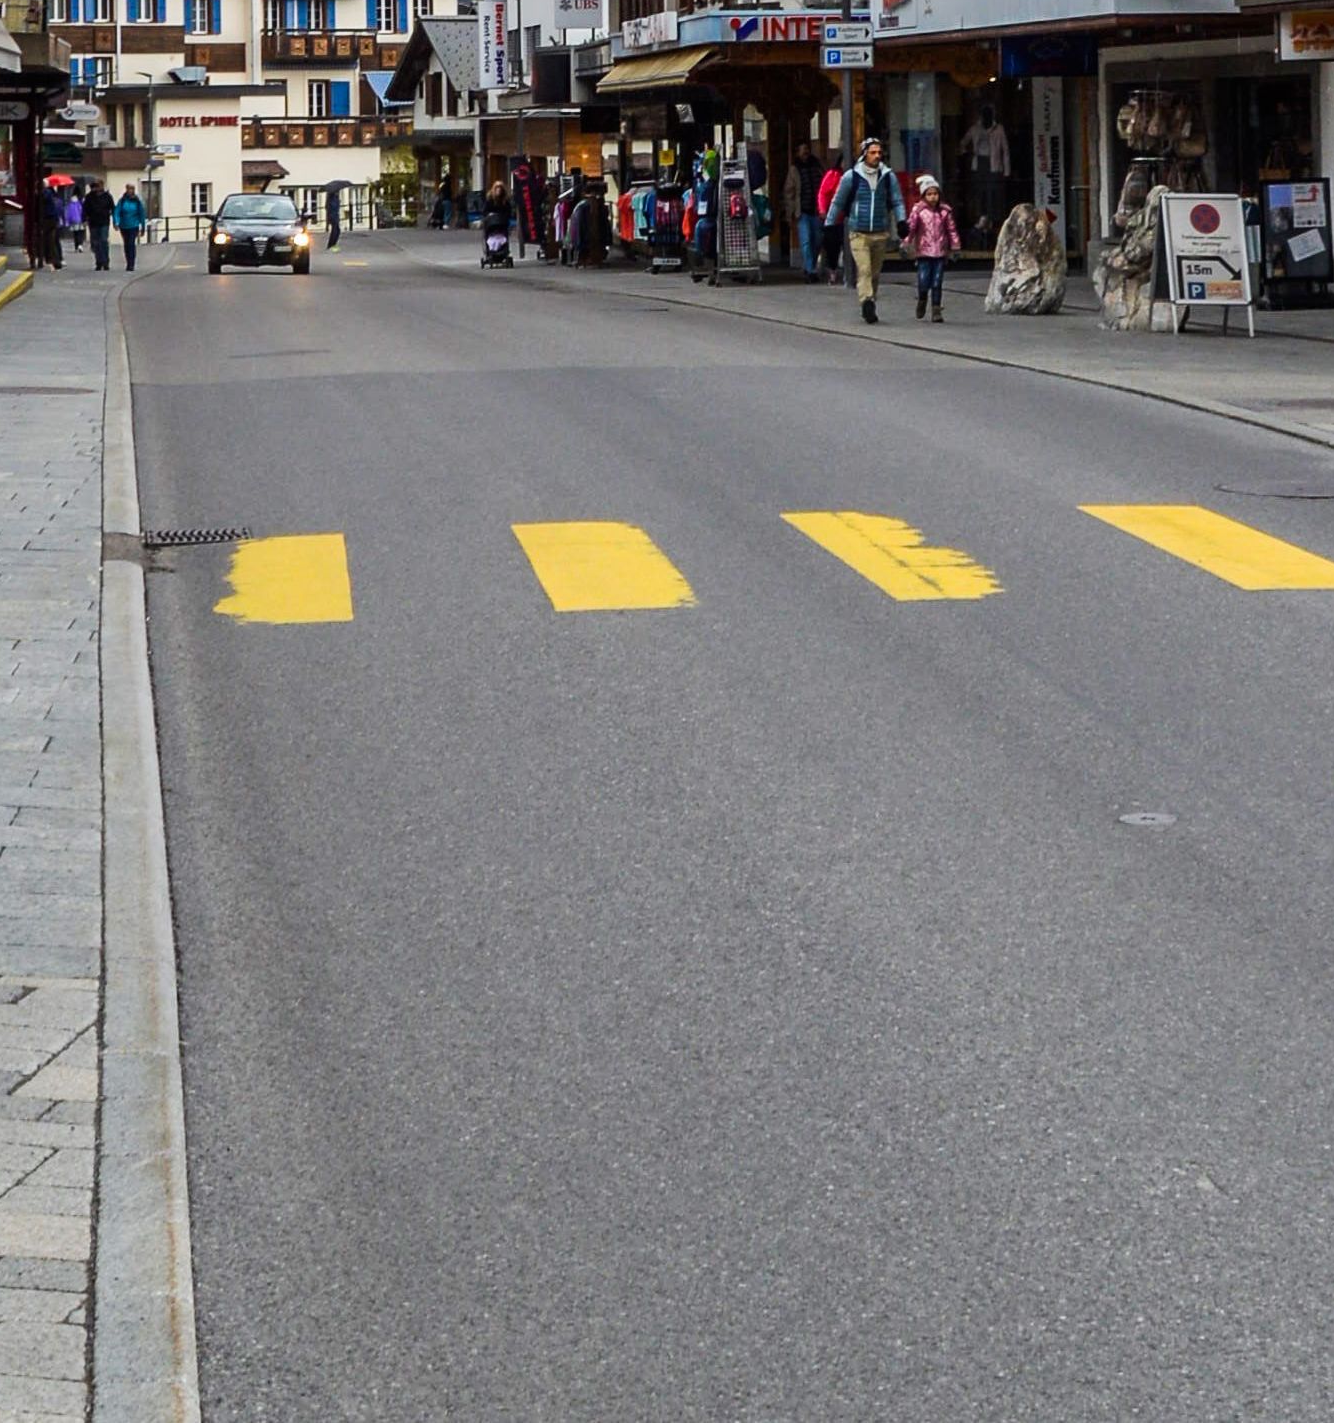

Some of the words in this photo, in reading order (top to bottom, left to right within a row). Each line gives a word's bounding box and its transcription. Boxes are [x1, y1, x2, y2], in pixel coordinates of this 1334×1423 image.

[495, 3, 505, 46] Bernet
[496, 49, 505, 85] Sport
[159, 116, 197, 128] HOTEL
[1047, 136, 1060, 205] Kaufmann
[1185, 264, 1213, 276] 15m
